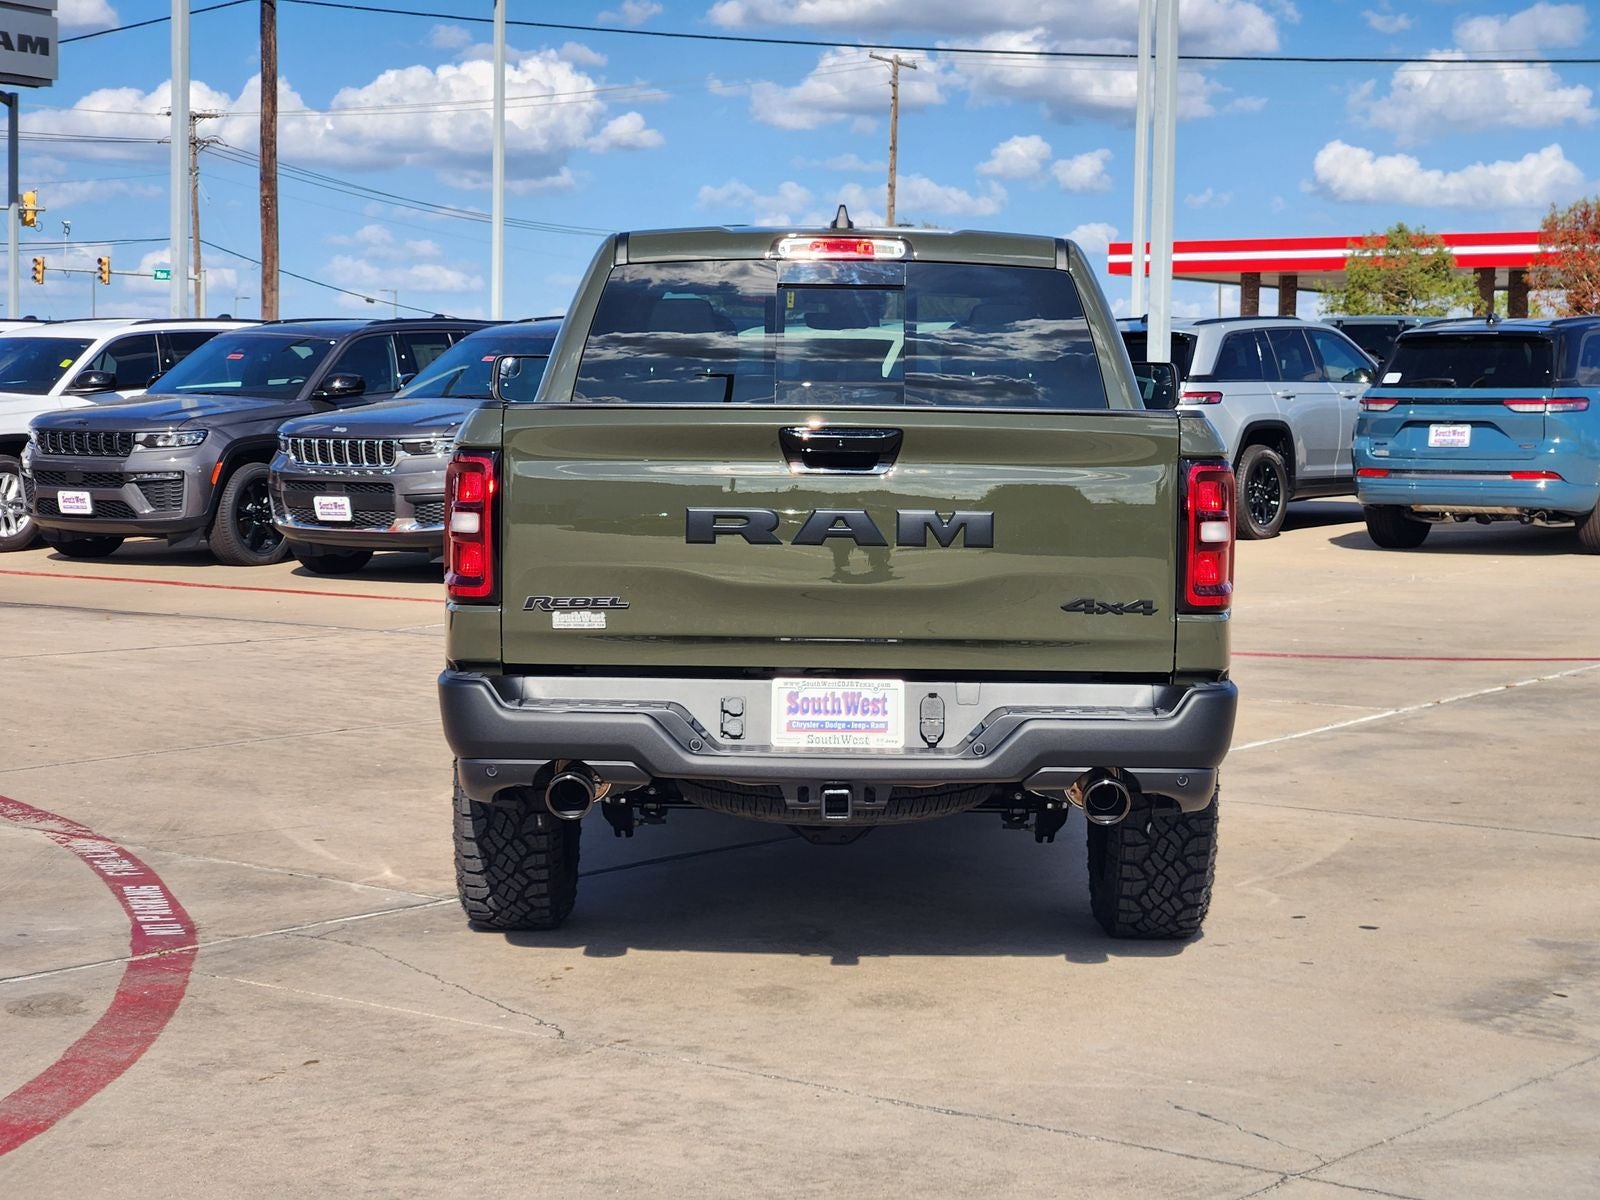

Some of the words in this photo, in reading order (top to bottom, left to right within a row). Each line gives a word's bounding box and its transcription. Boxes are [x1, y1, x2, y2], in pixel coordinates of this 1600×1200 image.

[685, 506, 994, 548] RAM
[523, 596, 630, 611] REBEL
[786, 690, 889, 717] SouthWest
[791, 721, 820, 729] Chrysler
[825, 722, 846, 730] Dodge
[806, 734, 871, 745] SouthWest
[122, 885, 177, 922] PARKING
